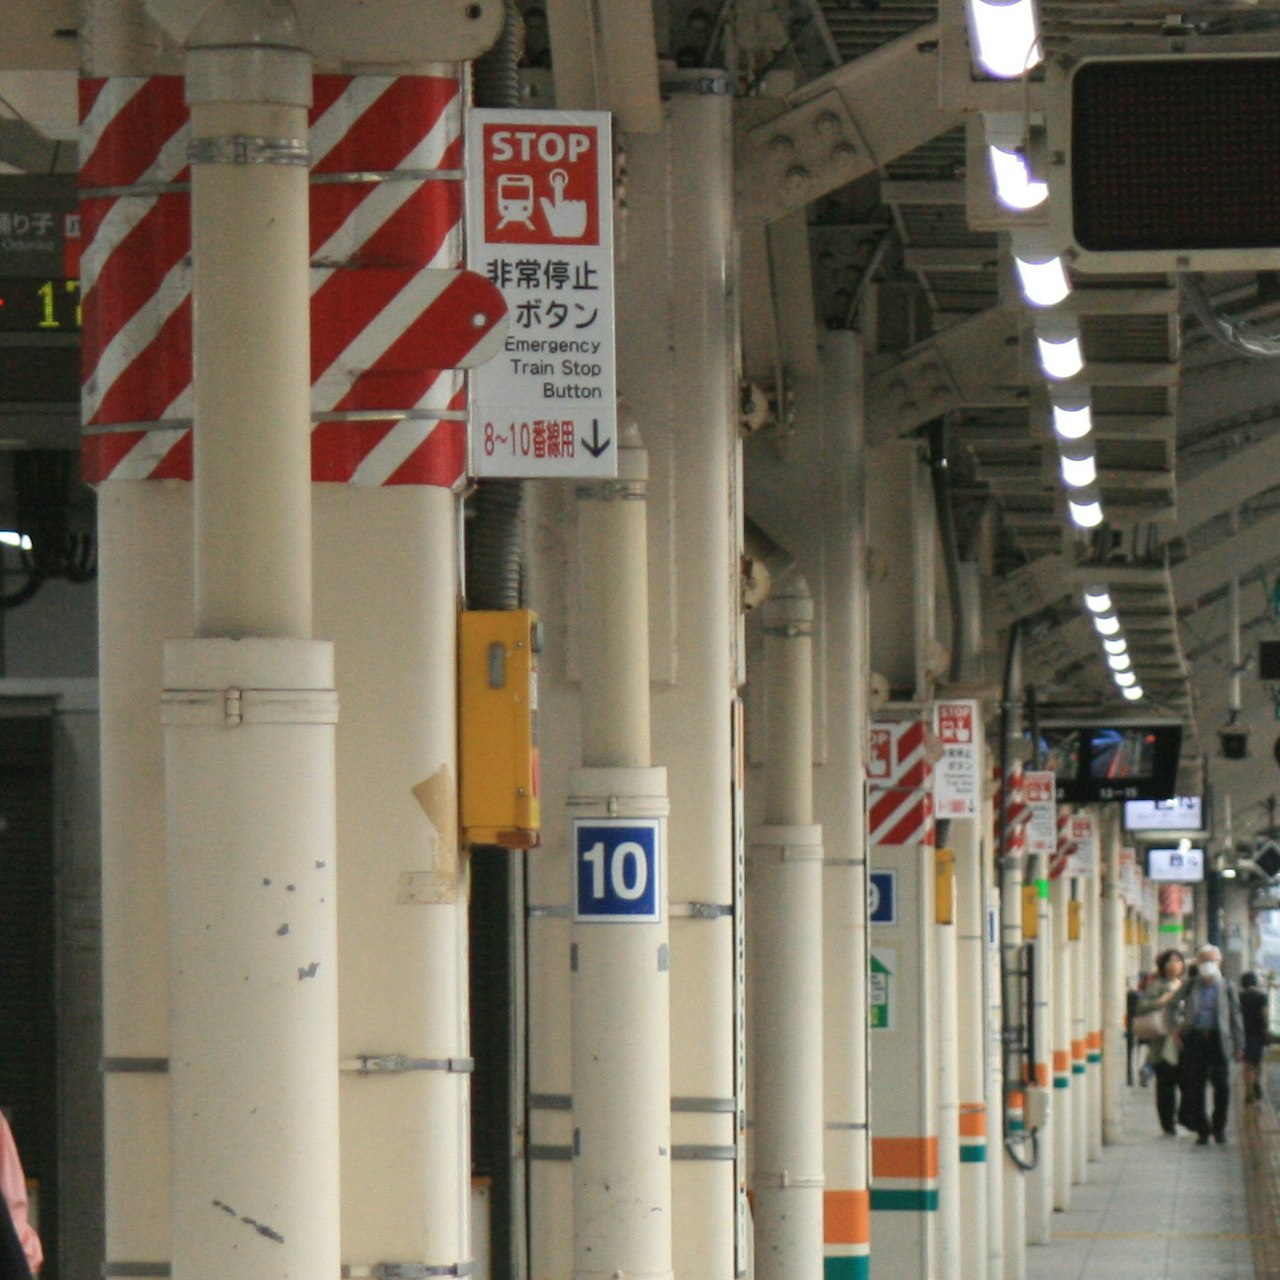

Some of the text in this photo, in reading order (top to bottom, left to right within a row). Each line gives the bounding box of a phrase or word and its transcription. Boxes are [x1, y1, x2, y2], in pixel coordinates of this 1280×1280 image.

[491, 131, 590, 162] STOP
[487, 259, 599, 290] 非常停止
[516, 300, 598, 328] ボタン
[505, 336, 601, 354] Emergency
[511, 359, 602, 377] Train Stop
[543, 383, 602, 398] Button
[583, 841, 648, 900] 10
